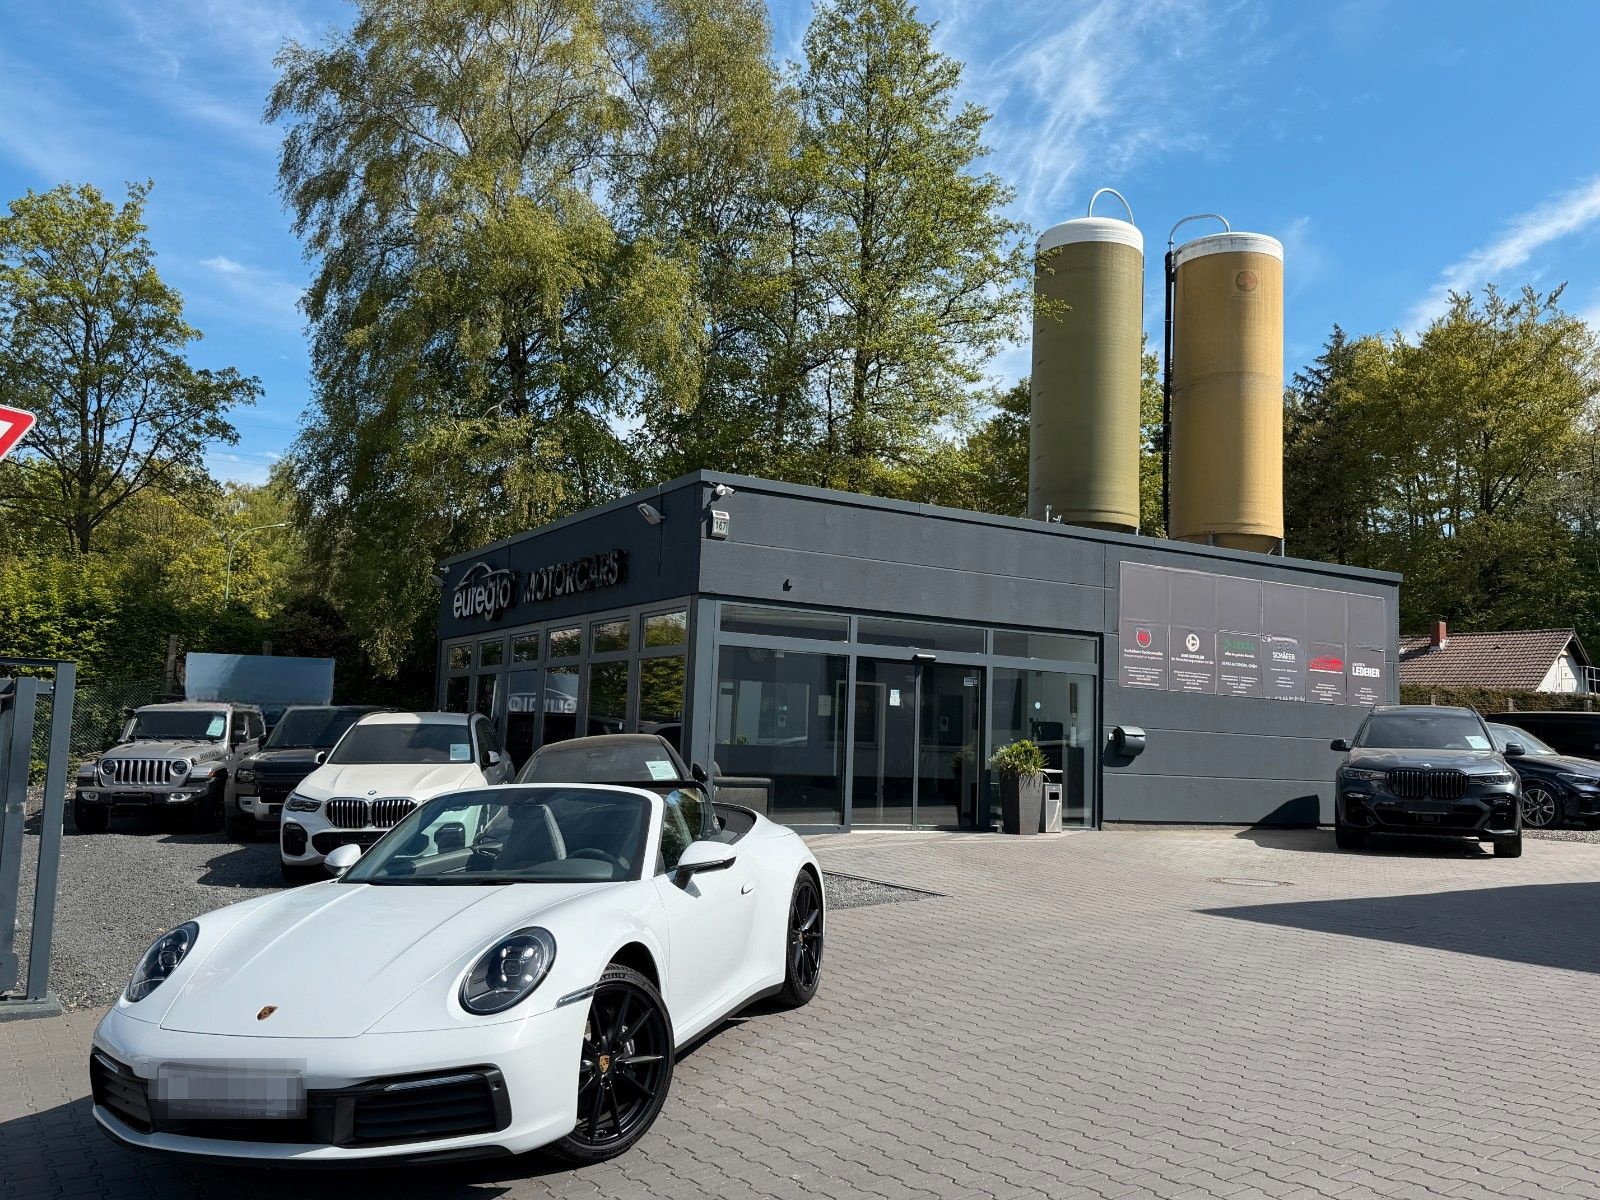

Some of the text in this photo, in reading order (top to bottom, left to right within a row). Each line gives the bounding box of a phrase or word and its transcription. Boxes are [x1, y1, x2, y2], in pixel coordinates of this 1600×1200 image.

[715, 520, 727, 531] 167
[453, 552, 621, 622] euregio MOTORCARS
[1352, 666, 1380, 678] LEDERER
